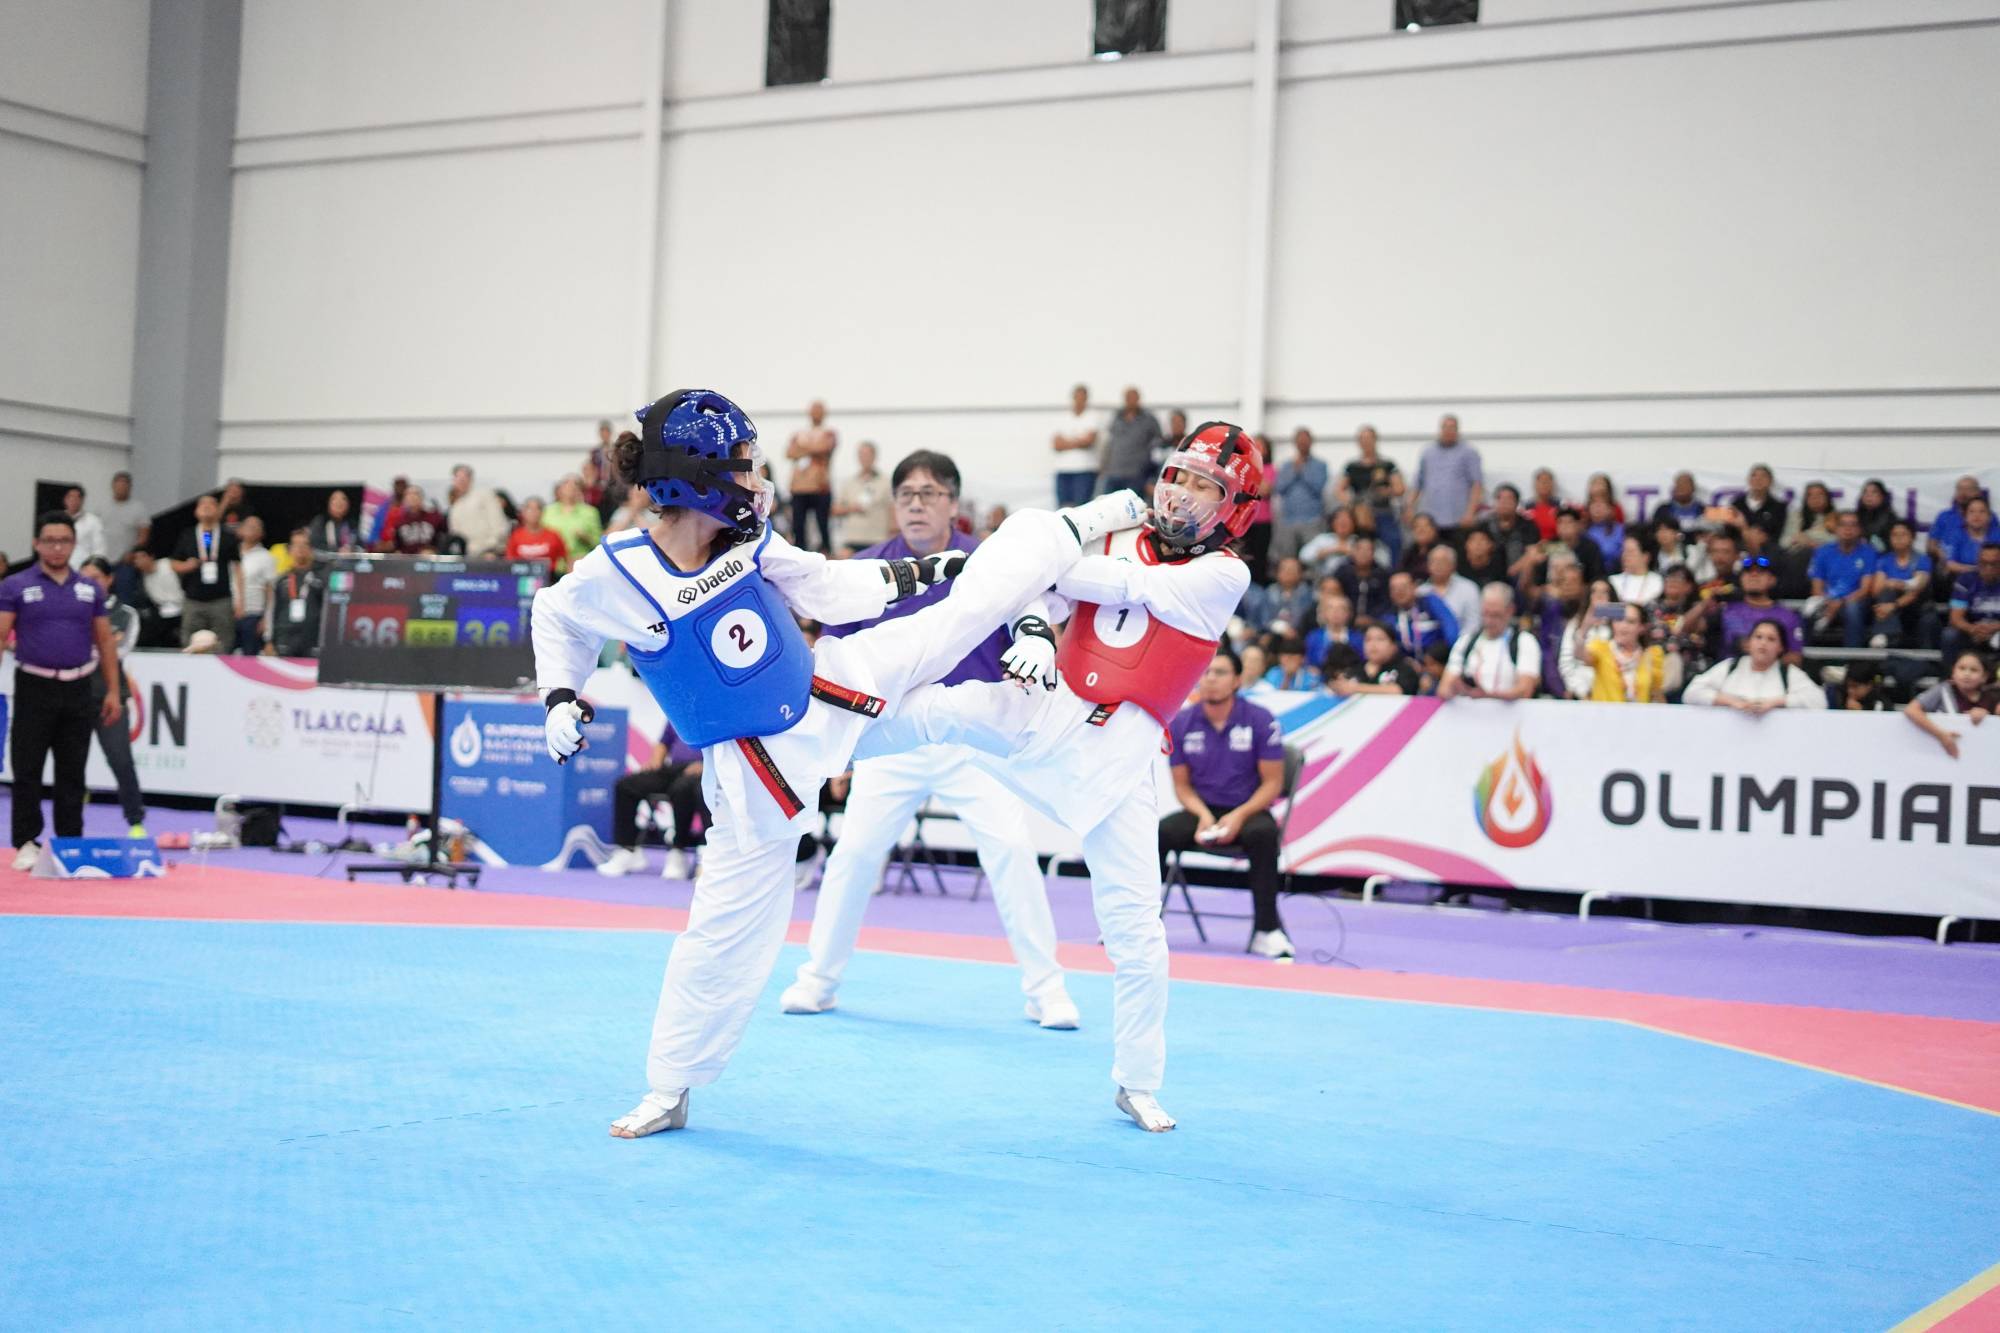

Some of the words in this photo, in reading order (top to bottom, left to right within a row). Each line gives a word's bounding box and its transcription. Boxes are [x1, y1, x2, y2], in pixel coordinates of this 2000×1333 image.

[697, 560, 744, 595] Daedo
[353, 616, 399, 647] 36
[464, 620, 510, 647] 36
[1114, 608, 1130, 632] 1
[729, 624, 754, 652] 2
[1085, 671, 1098, 687] 0
[292, 708, 406, 736] TLAXCALA
[780, 704, 795, 720] 2
[1600, 769, 2000, 846] OLIMPIAD
